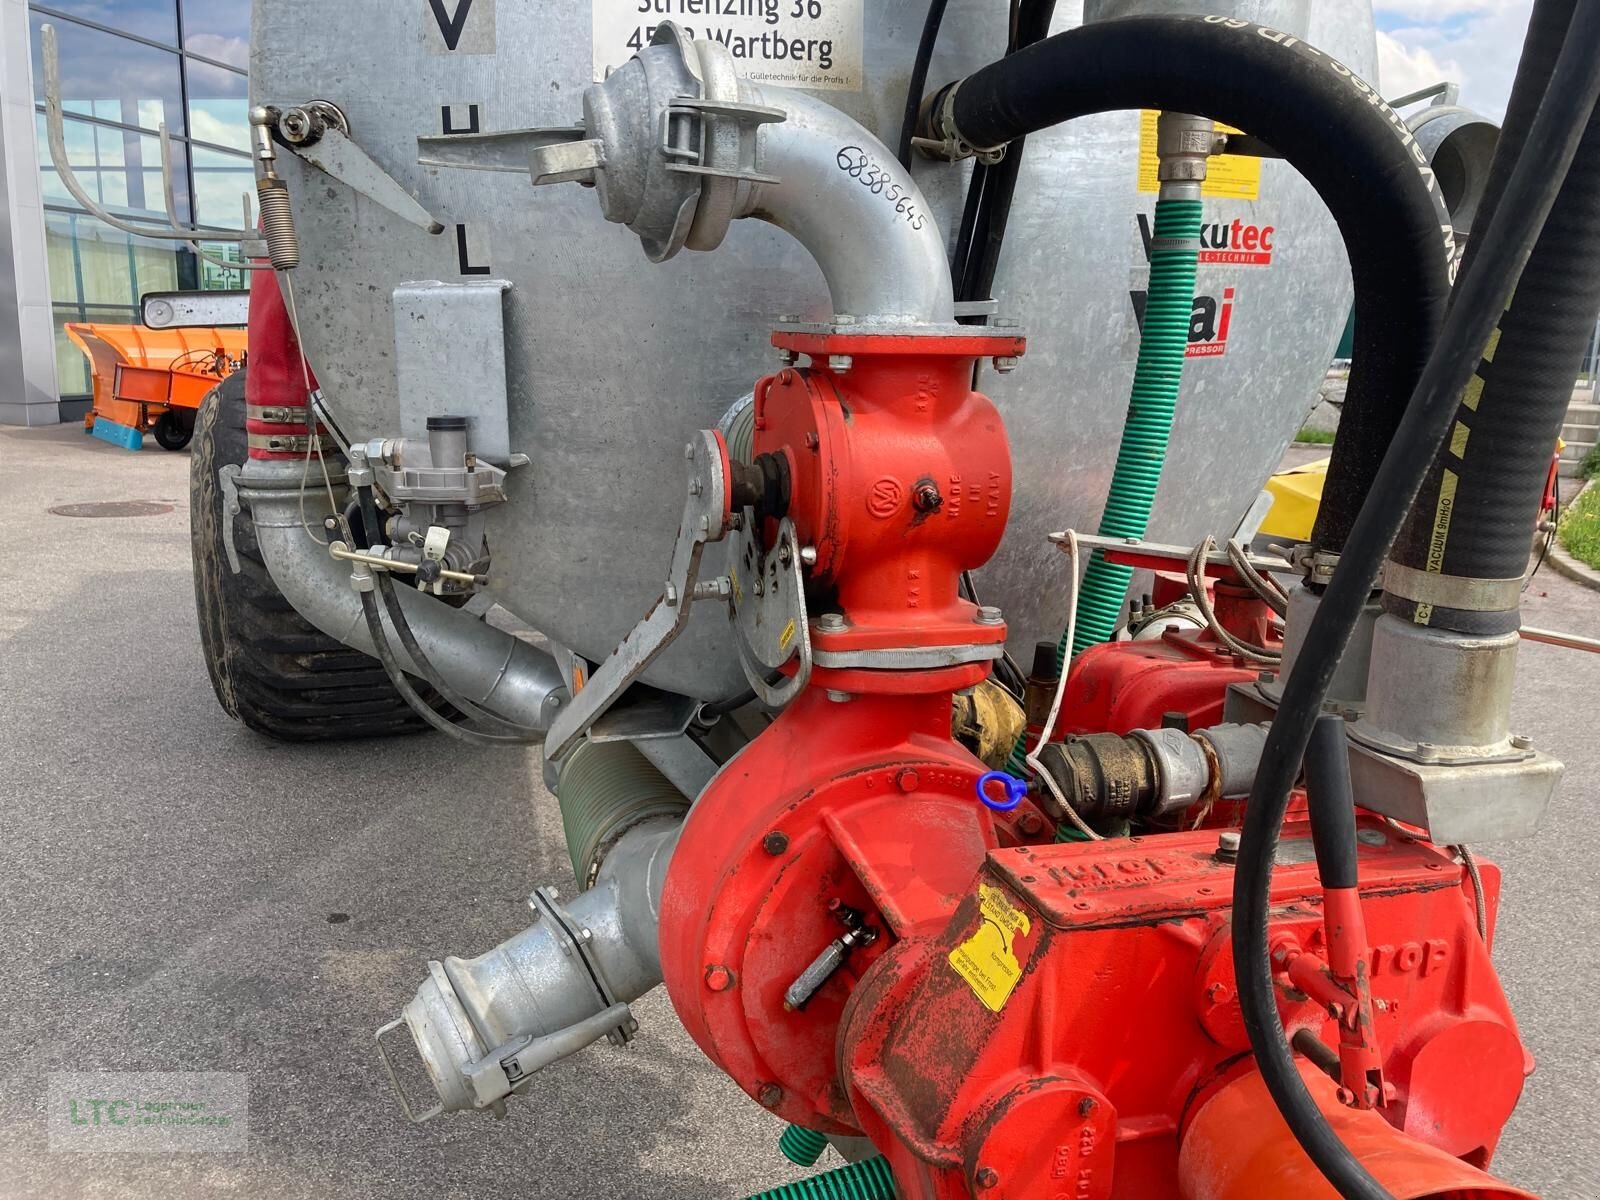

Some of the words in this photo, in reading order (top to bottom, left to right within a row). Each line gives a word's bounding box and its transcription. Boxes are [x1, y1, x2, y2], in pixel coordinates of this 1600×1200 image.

[428, 0, 472, 51] V
[790, 0, 822, 20] 36
[1203, 14, 1249, 29] 60
[1257, 27, 1298, 48] ID
[750, 71, 796, 82] Gülletechnik
[798, 73, 809, 82] für
[810, 75, 822, 83] die
[1330, 60, 1436, 193] Vakutec
[836, 145, 929, 231] 68385645
[456, 223, 491, 275] L
[949, 473, 961, 517] MADE
[986, 471, 1000, 517] ITALY
[1429, 531, 1445, 573] VACUUM
[991, 951, 1014, 977] Kompressor
